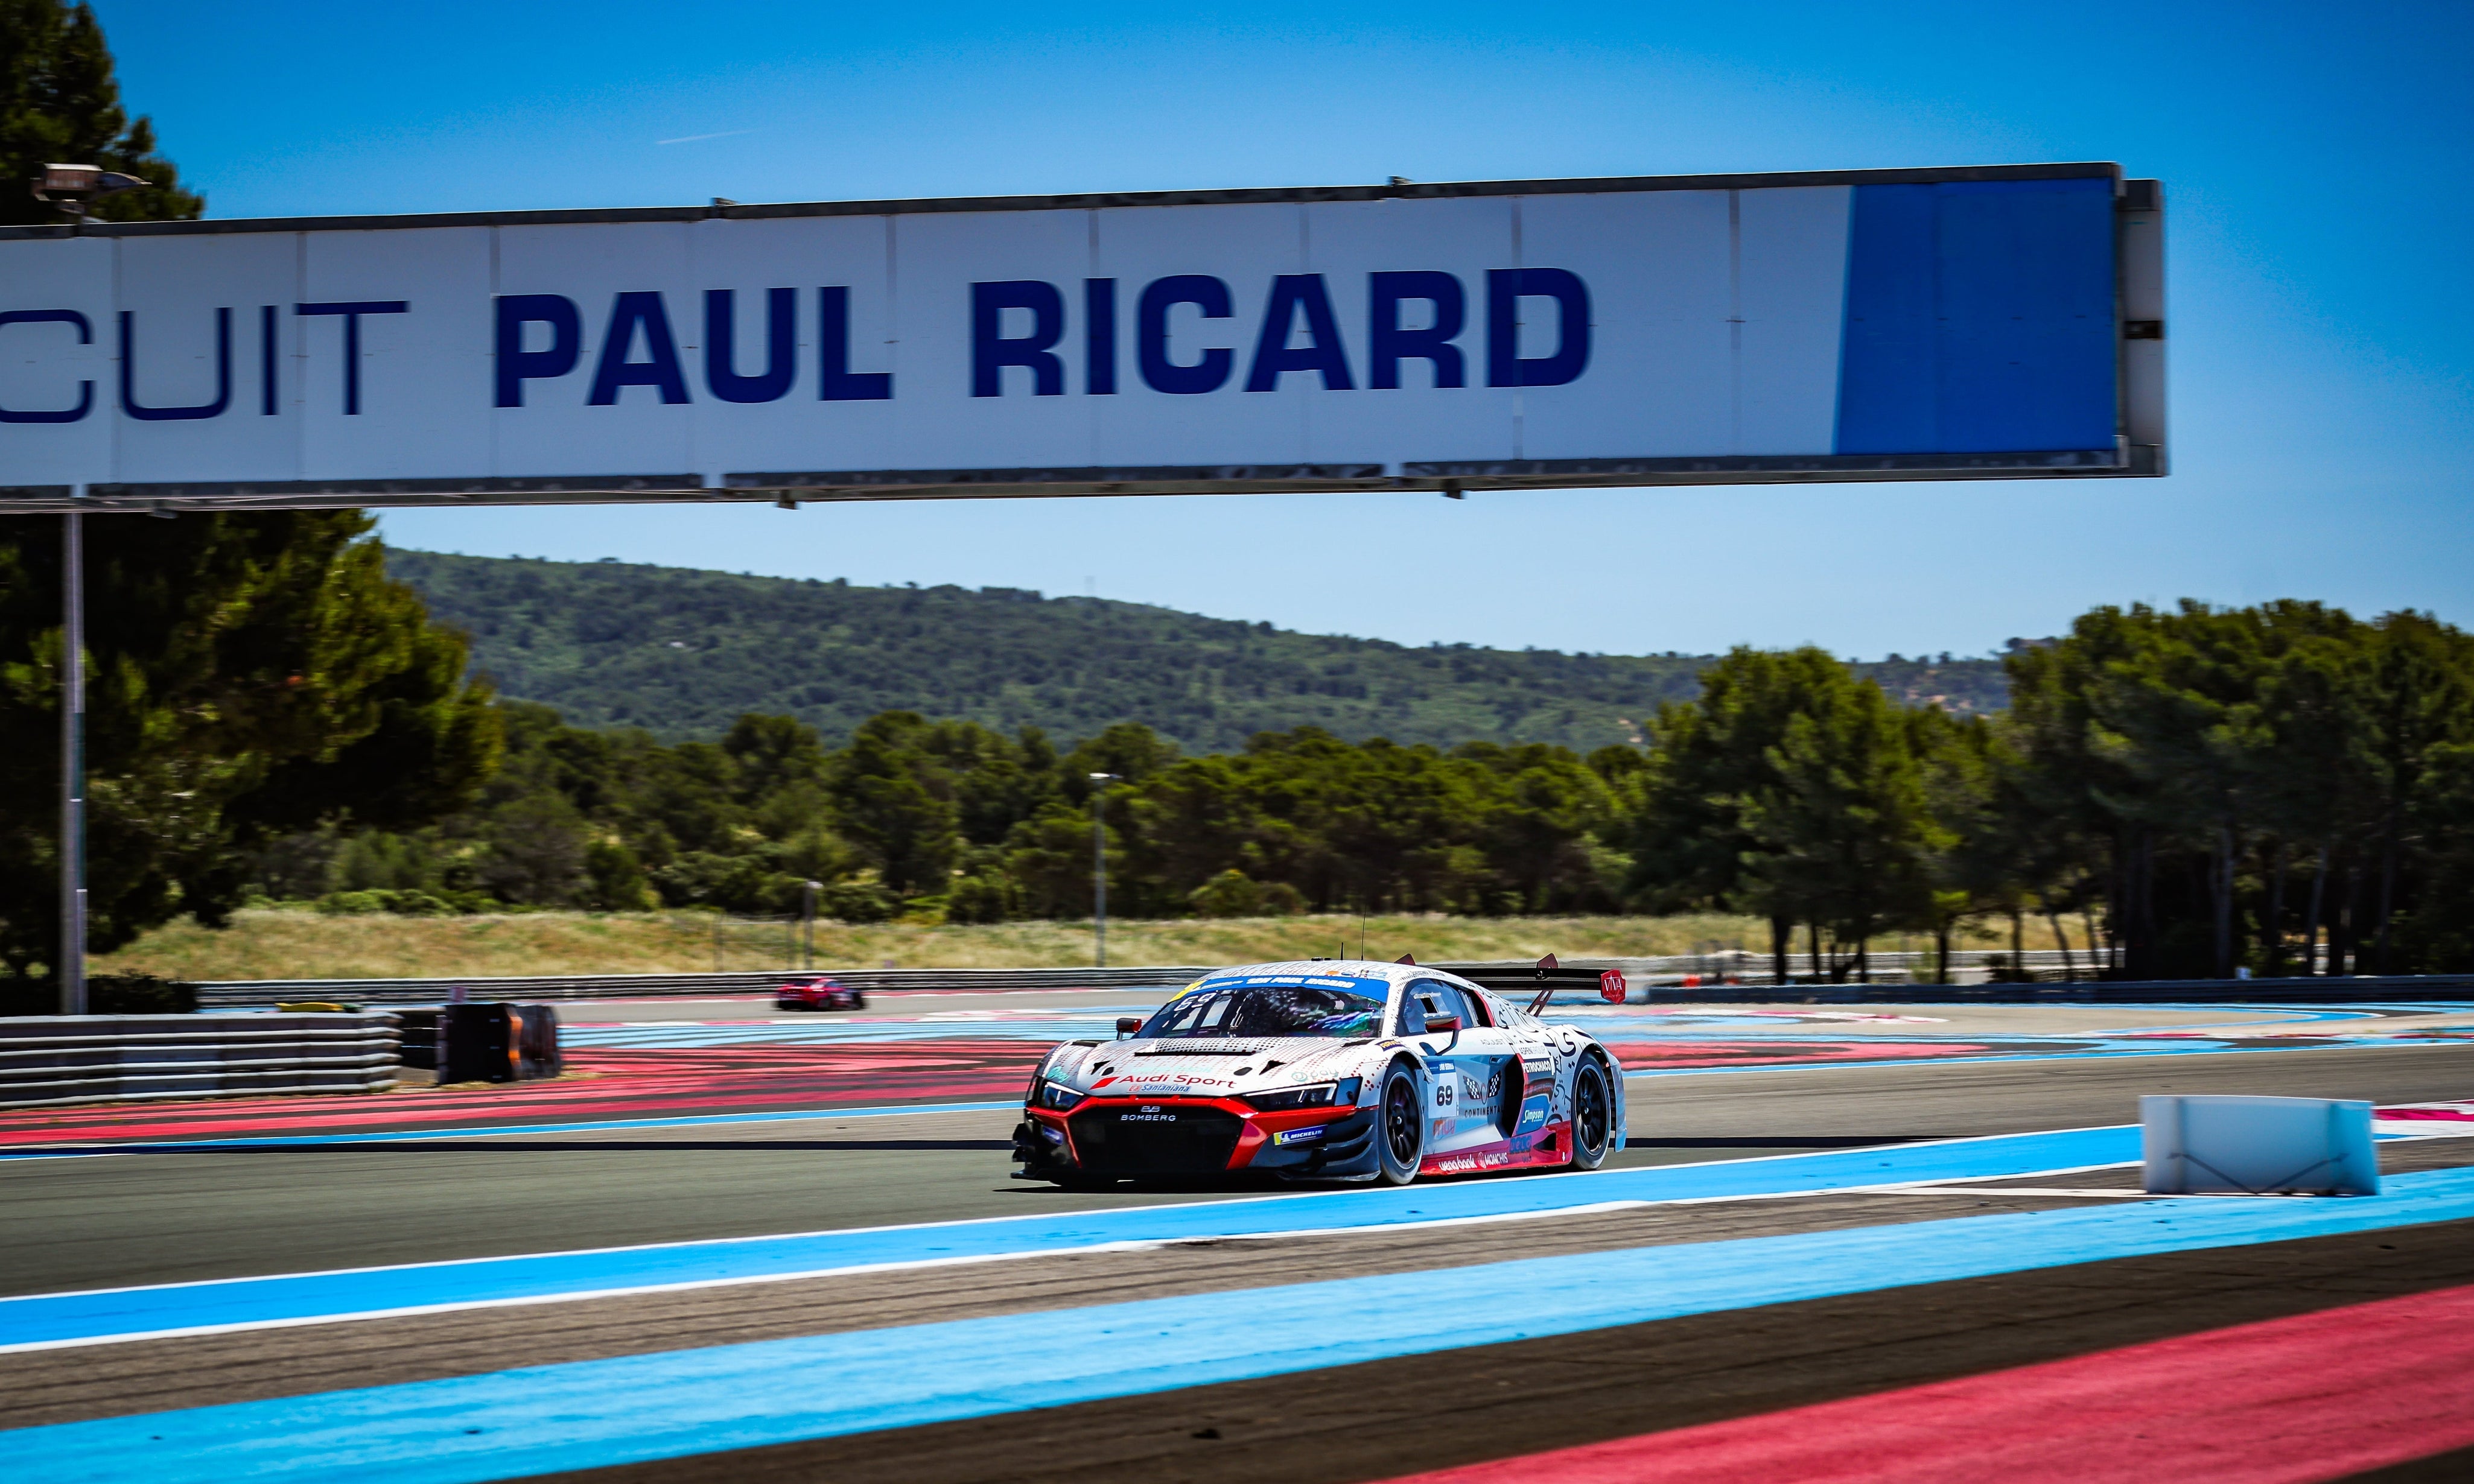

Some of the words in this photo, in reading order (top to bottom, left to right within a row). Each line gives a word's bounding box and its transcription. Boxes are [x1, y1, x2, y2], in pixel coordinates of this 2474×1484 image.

[0, 300, 411, 423] CUIT
[492, 285, 895, 408] PAUL
[970, 267, 1594, 397] RICARD
[1305, 978, 1356, 988] RICARD
[1604, 975, 1622, 992] VIVA
[1174, 992, 1217, 1012] 69
[1522, 1060, 1551, 1073] PETROCHACO
[1118, 1074, 1170, 1083] Audi
[1174, 1074, 1237, 1088] Sport
[1436, 1085, 1453, 1106] 69
[1464, 1105, 1504, 1118] CONTINENTAL
[1522, 1109, 1544, 1123] Simpson
[1291, 1130, 1323, 1139] MICHELIN
[1484, 1152, 1508, 1166] MONCHIS
